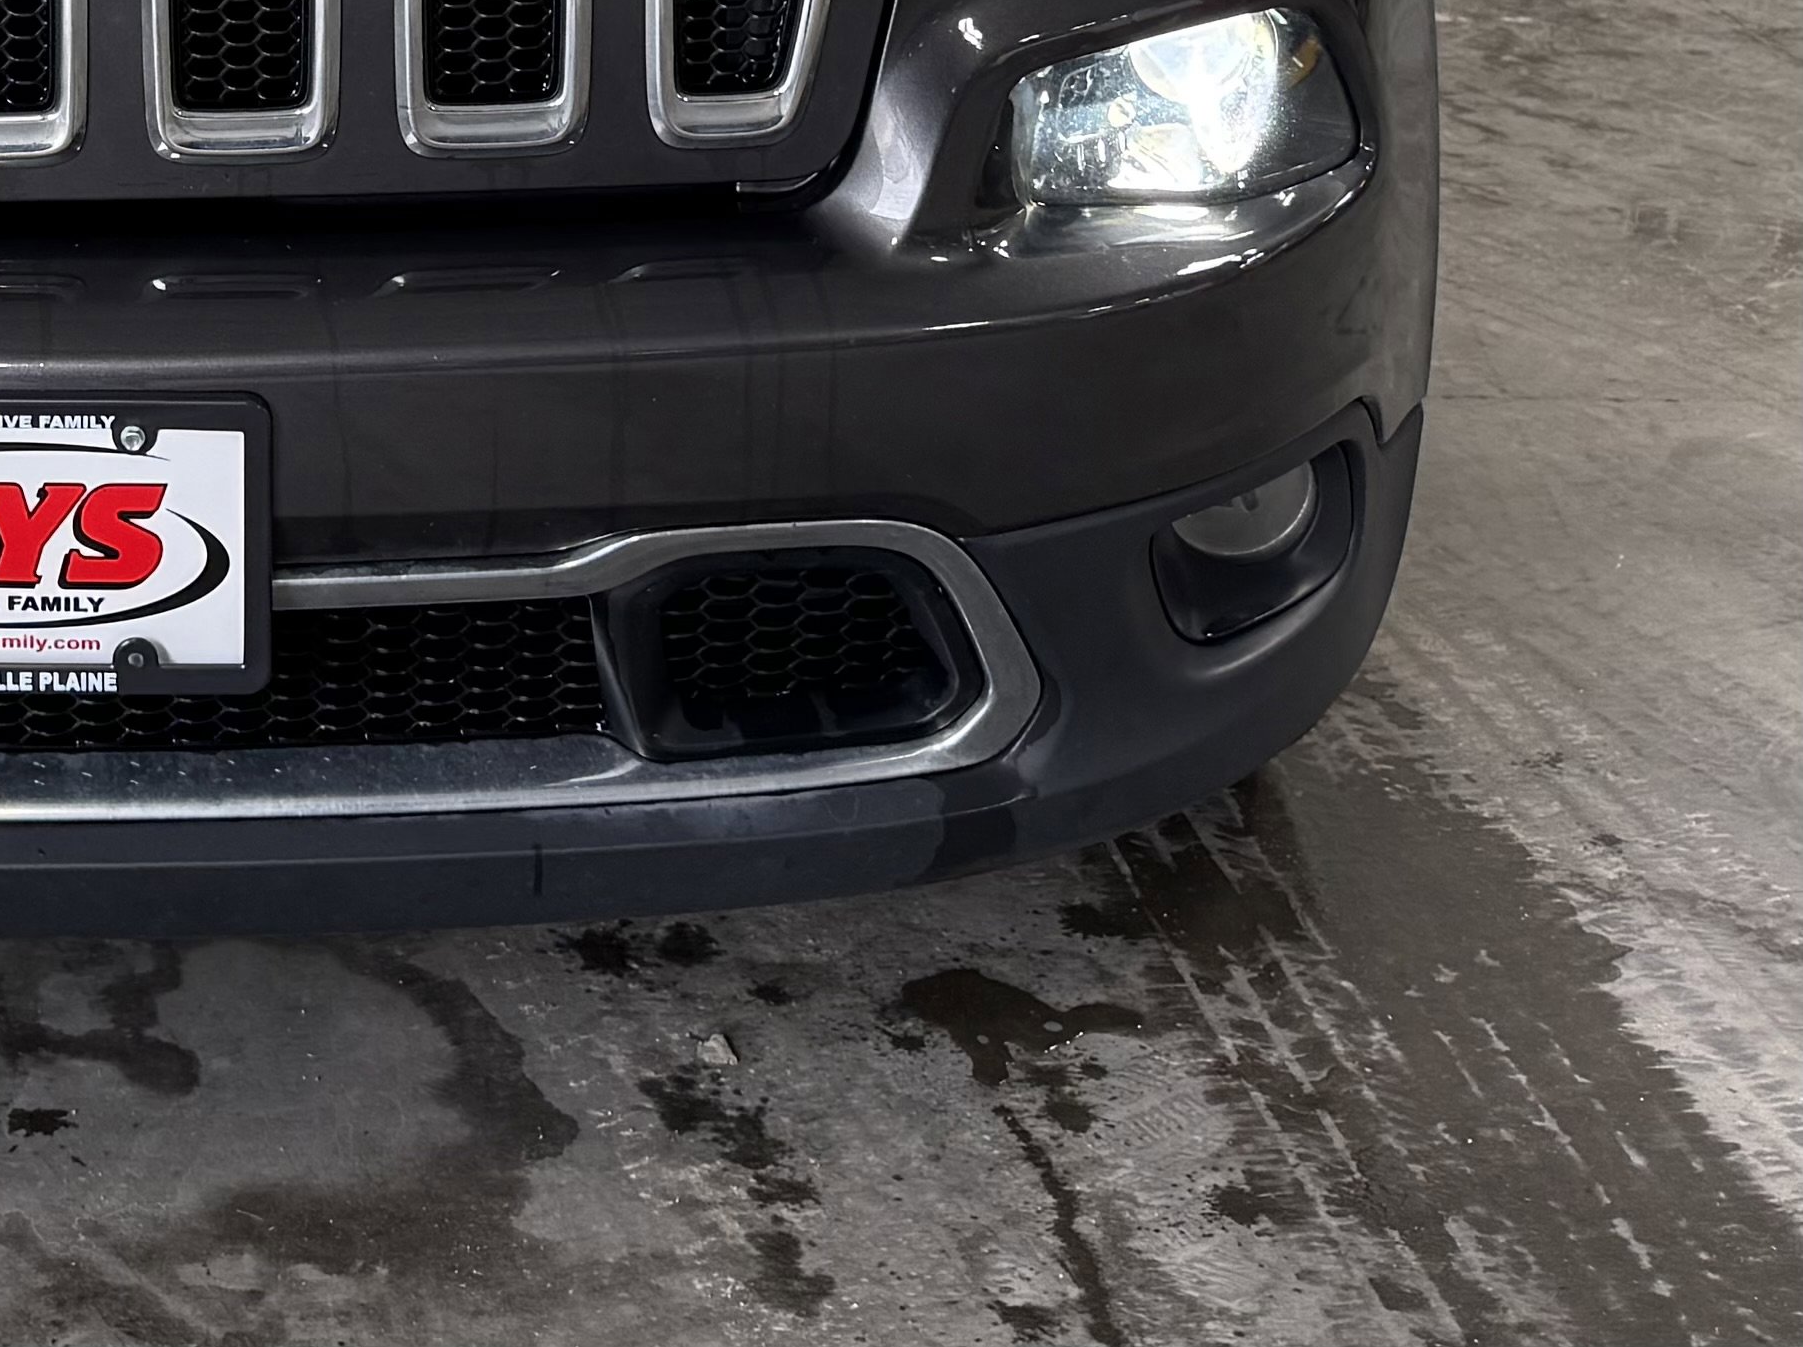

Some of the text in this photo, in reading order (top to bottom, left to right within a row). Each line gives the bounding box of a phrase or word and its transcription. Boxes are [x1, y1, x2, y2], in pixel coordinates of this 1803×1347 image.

[38, 414, 116, 429] FAMILY
[7, 595, 106, 613] FAMILY
[39, 672, 118, 693] PLAINE
